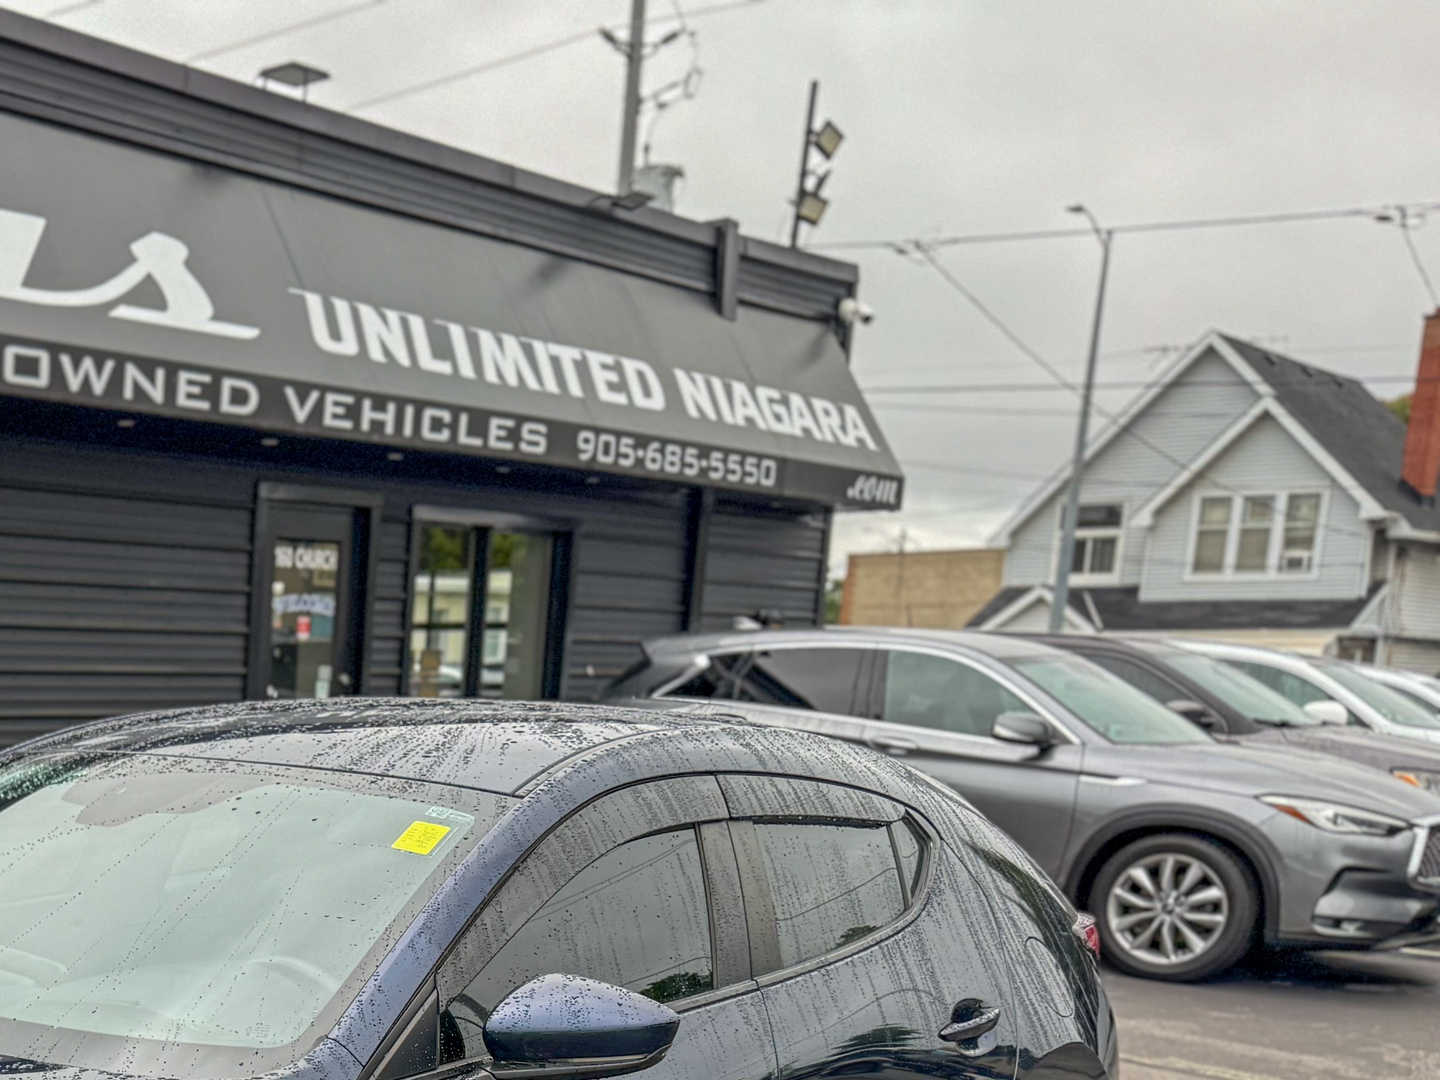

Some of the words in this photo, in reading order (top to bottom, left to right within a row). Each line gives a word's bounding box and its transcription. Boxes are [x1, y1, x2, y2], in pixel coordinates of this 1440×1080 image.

[287, 286, 667, 412] UNLIMITED
[672, 367, 879, 451] NIAGARA
[283, 385, 549, 456] VEHICLES
[846, 473, 898, 505] .com
